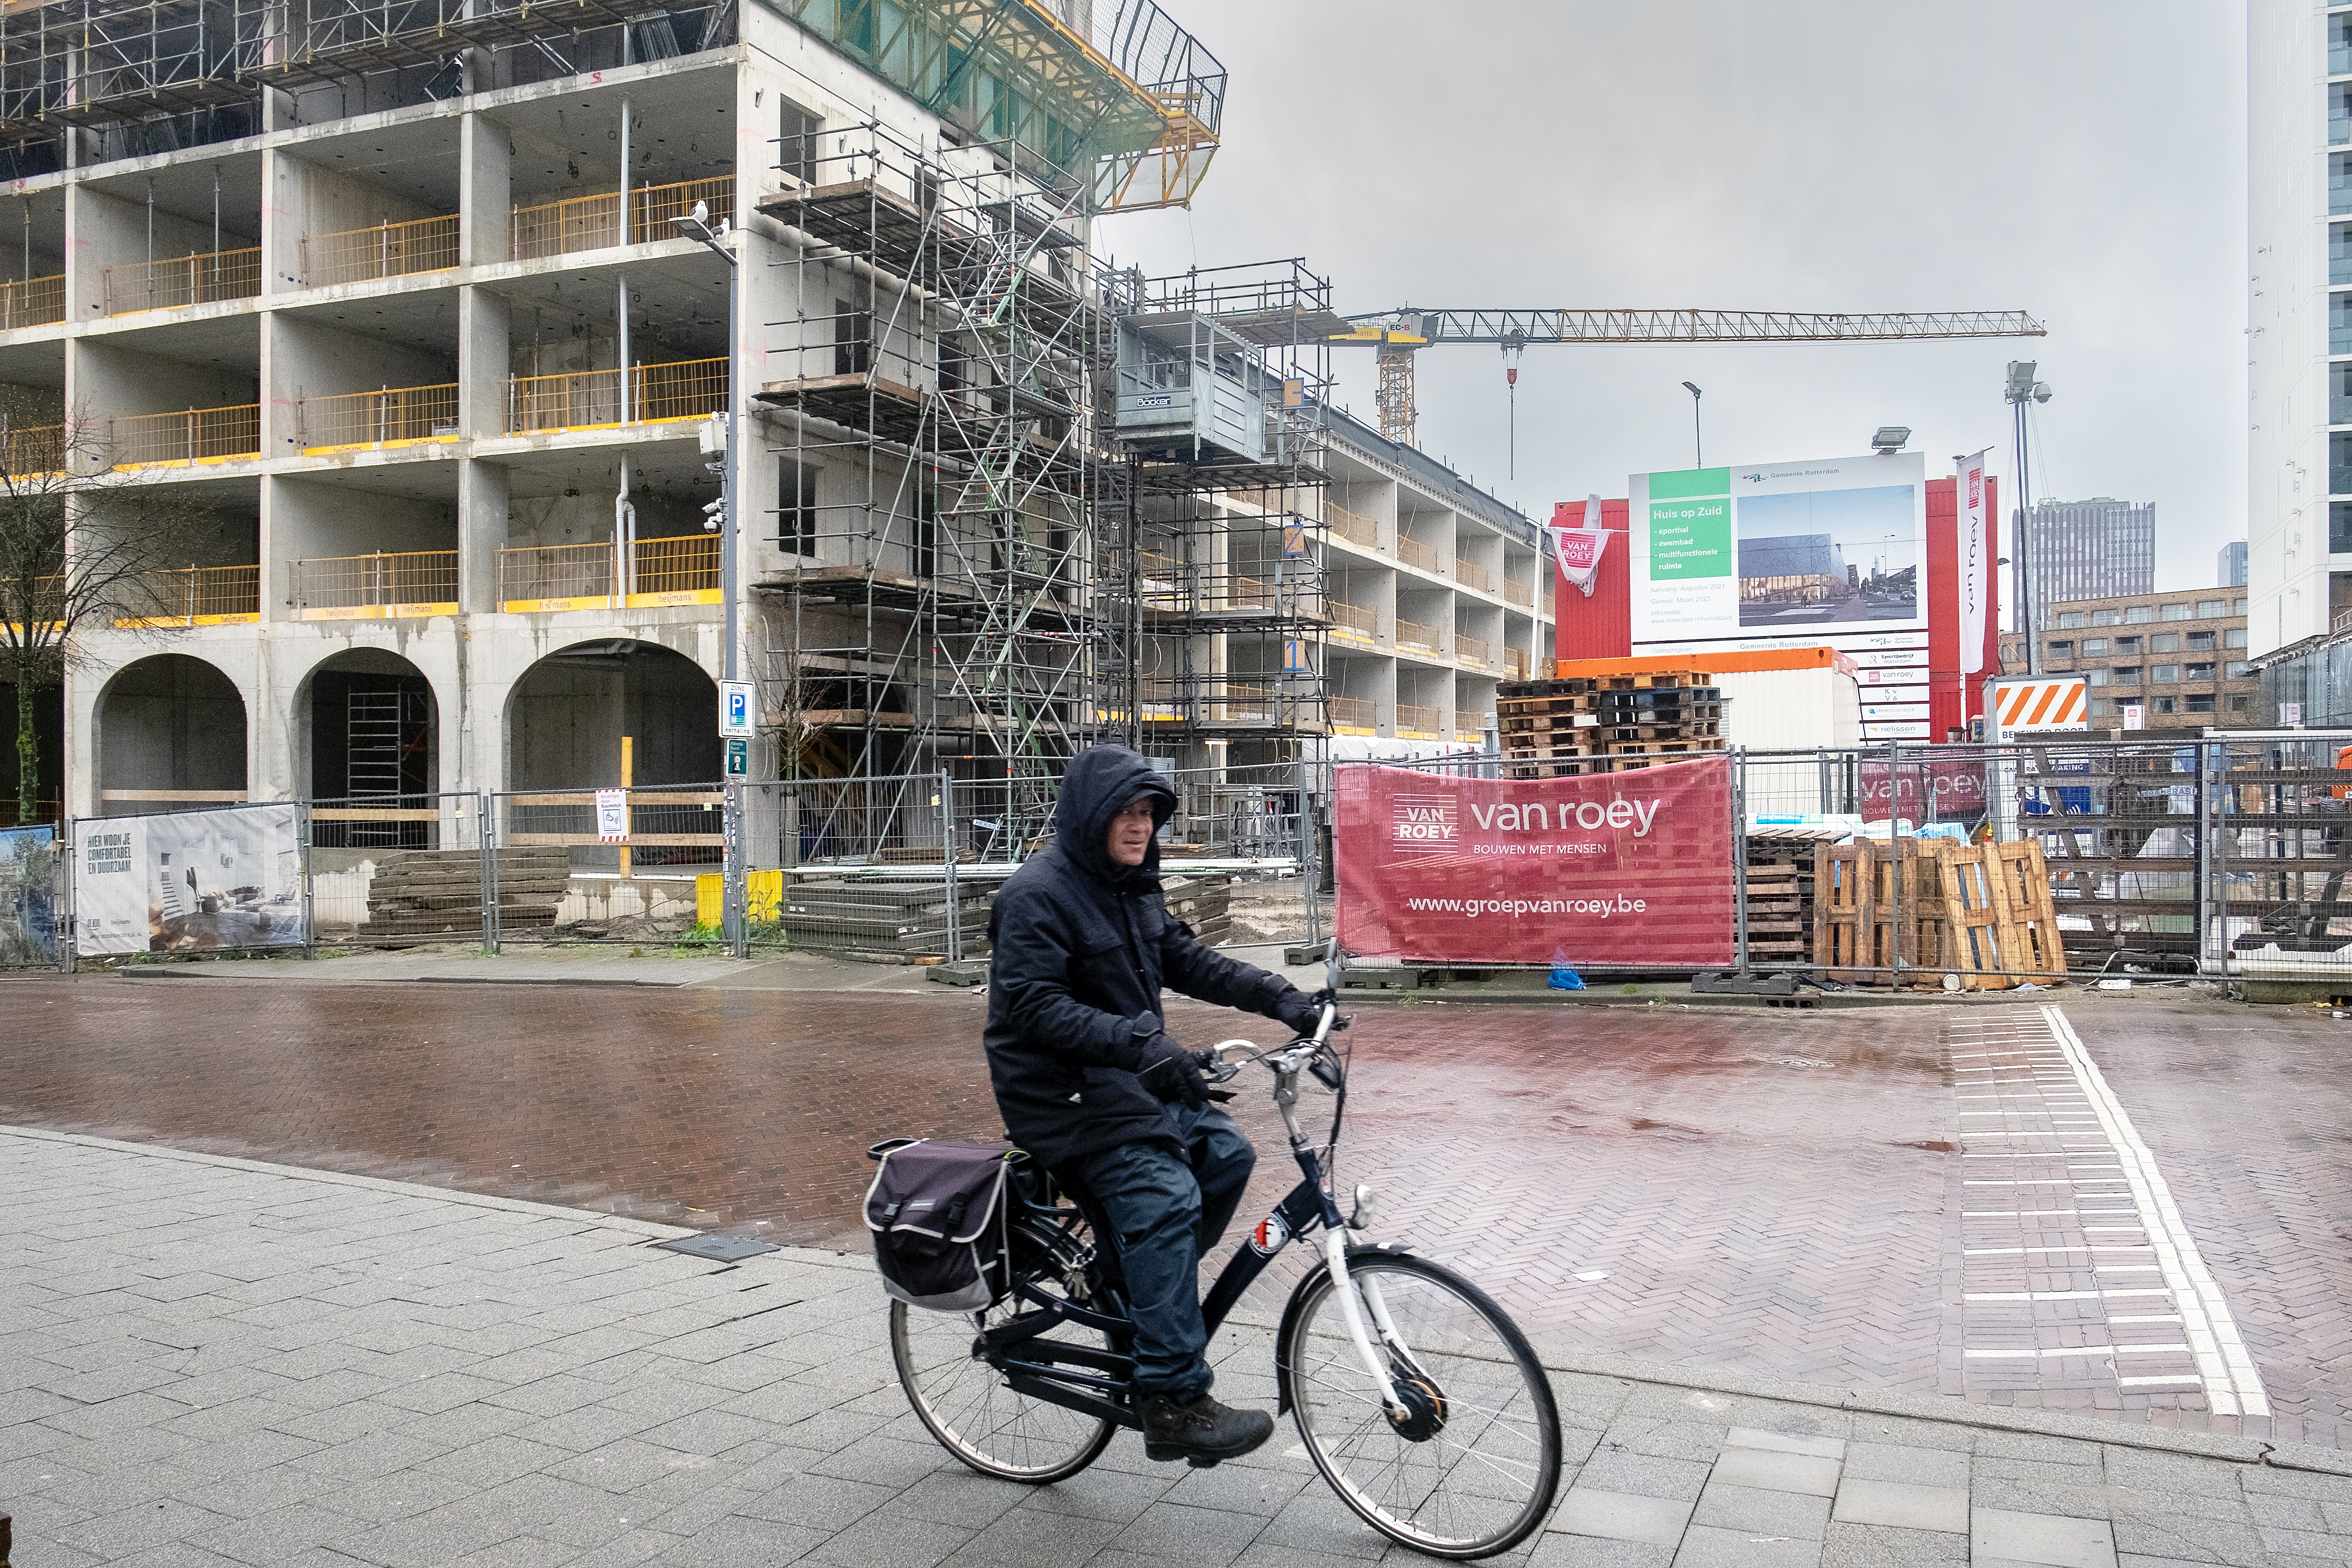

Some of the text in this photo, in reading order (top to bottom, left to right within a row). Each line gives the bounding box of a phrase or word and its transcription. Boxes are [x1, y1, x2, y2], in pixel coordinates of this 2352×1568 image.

[1137, 397, 1171, 406] Böcker
[1654, 506, 1722, 519] Huis op Zuid
[1659, 527, 1689, 535] sporthal
[1568, 542, 1588, 551] VAN
[1563, 550, 1592, 560] ROEY
[1659, 549, 1718, 558] multifunctionele
[658, 593, 692, 604] heijmans
[1651, 615, 1732, 624] www.rotterdam.nl/huisopzuid
[732, 695, 743, 715] P
[1408, 807, 1444, 822] VAN
[1470, 799, 1661, 837] van roey
[976, 821, 996, 829] HERAS
[1398, 824, 1453, 839] ROEY
[88, 833, 130, 847] HIER WOON JE
[88, 847, 131, 860] COMFORTABEL
[1474, 844, 1606, 854] BOUWEN MET MENSEN
[88, 860, 131, 874] EN DUURZAAM
[1408, 893, 1646, 918] www.groepvanroey.be
